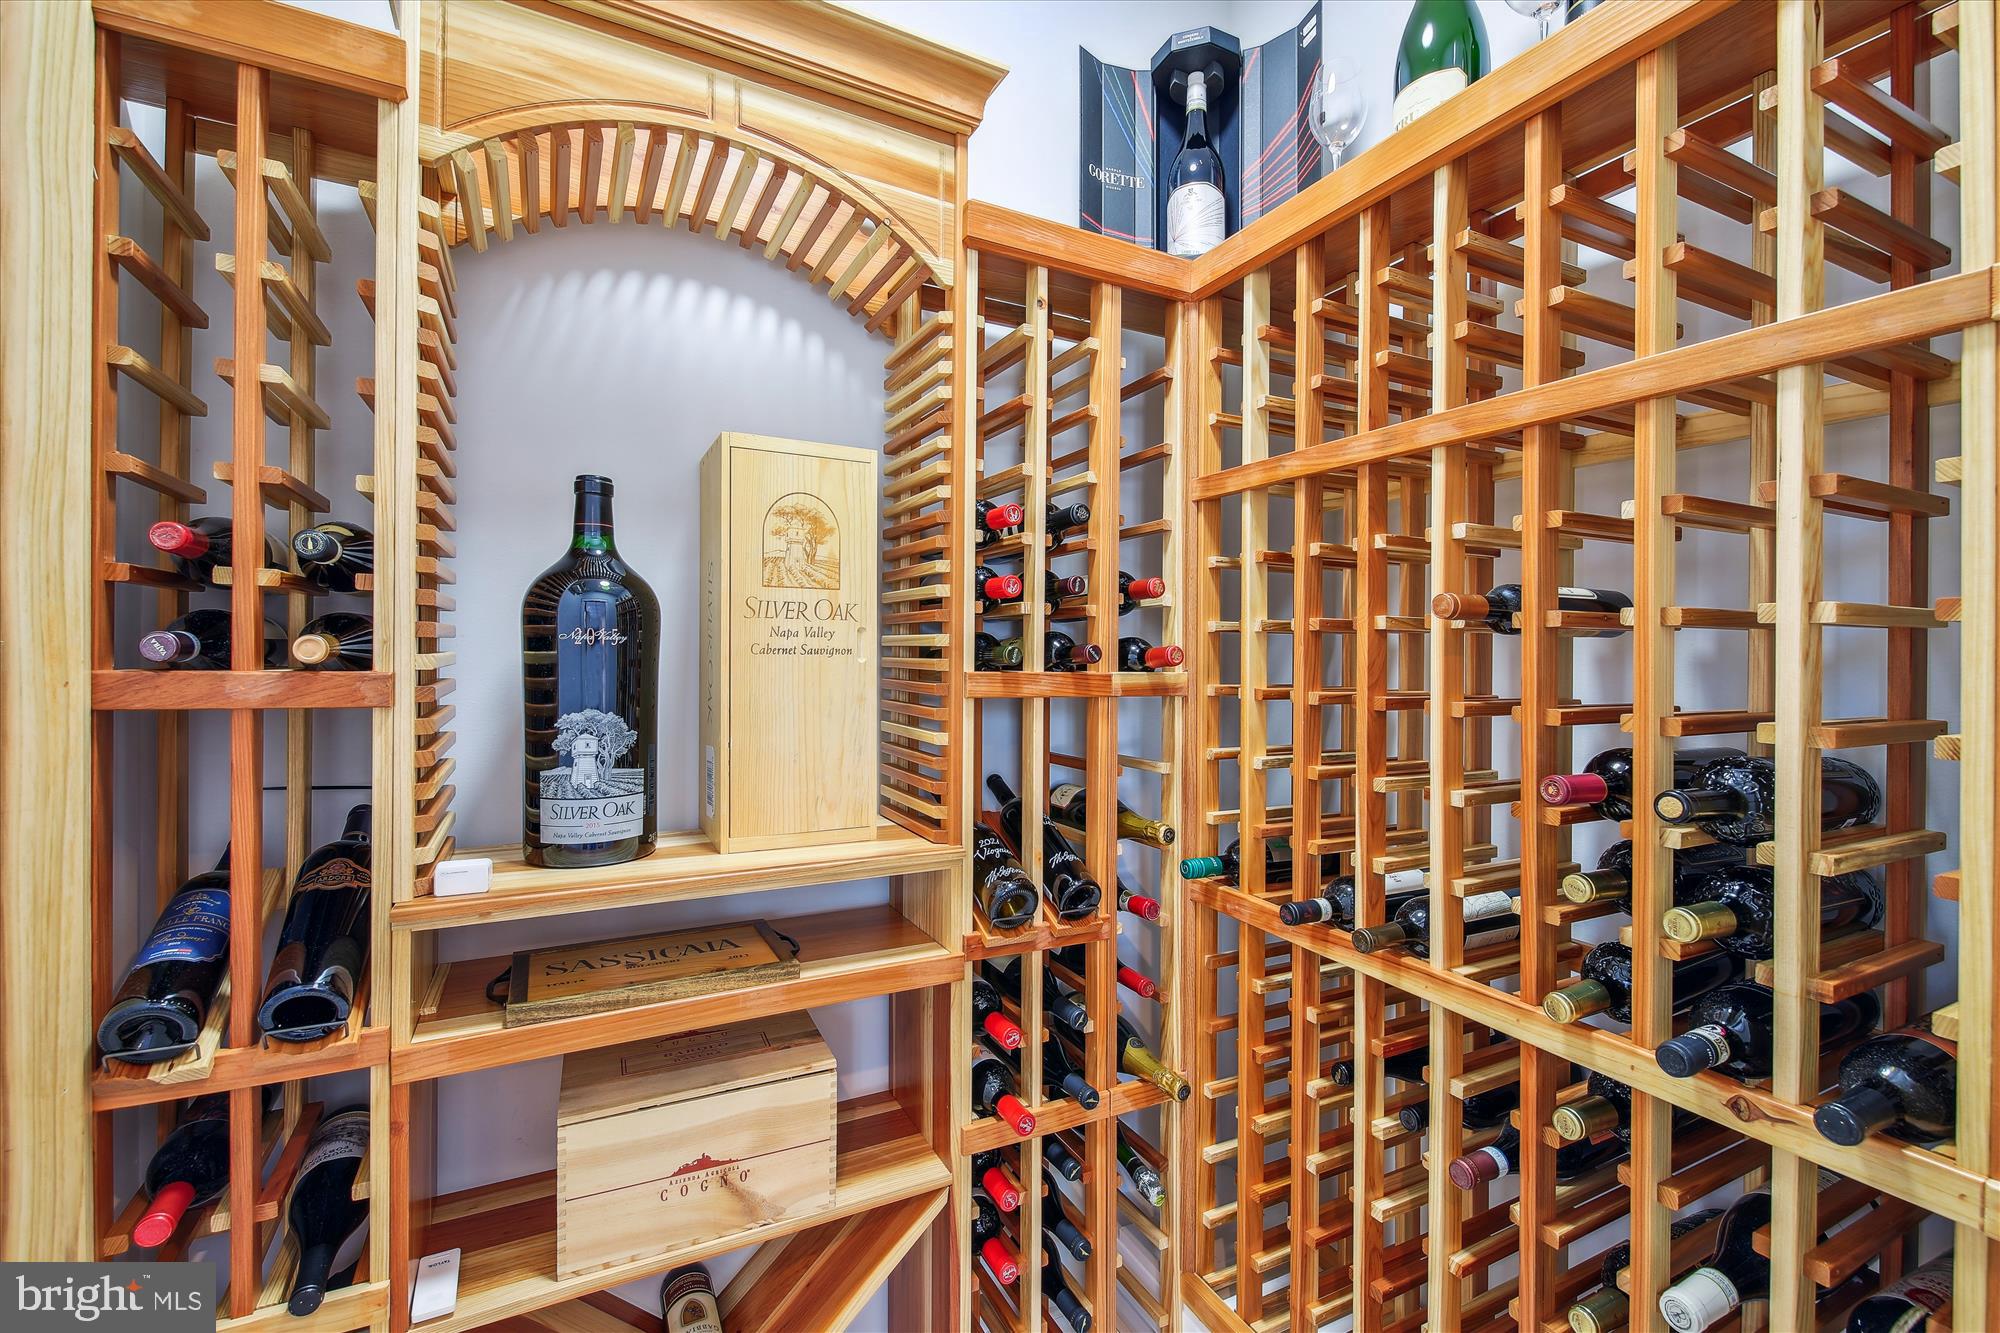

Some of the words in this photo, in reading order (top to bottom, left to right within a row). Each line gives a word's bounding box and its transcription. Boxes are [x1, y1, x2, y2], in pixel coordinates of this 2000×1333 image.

[743, 596, 811, 622] SILVER
[814, 599, 859, 623] OAK
[769, 626, 799, 640] Napa
[804, 626, 835, 641] Valley
[751, 643, 797, 656] Cabernet
[800, 643, 853, 658] Sauvignon
[550, 803, 600, 820] SILVER
[603, 800, 636, 818] OAK
[567, 832, 583, 840] Valley
[545, 938, 742, 976] SASSICAIA
[660, 1170, 746, 1202] COGNO
